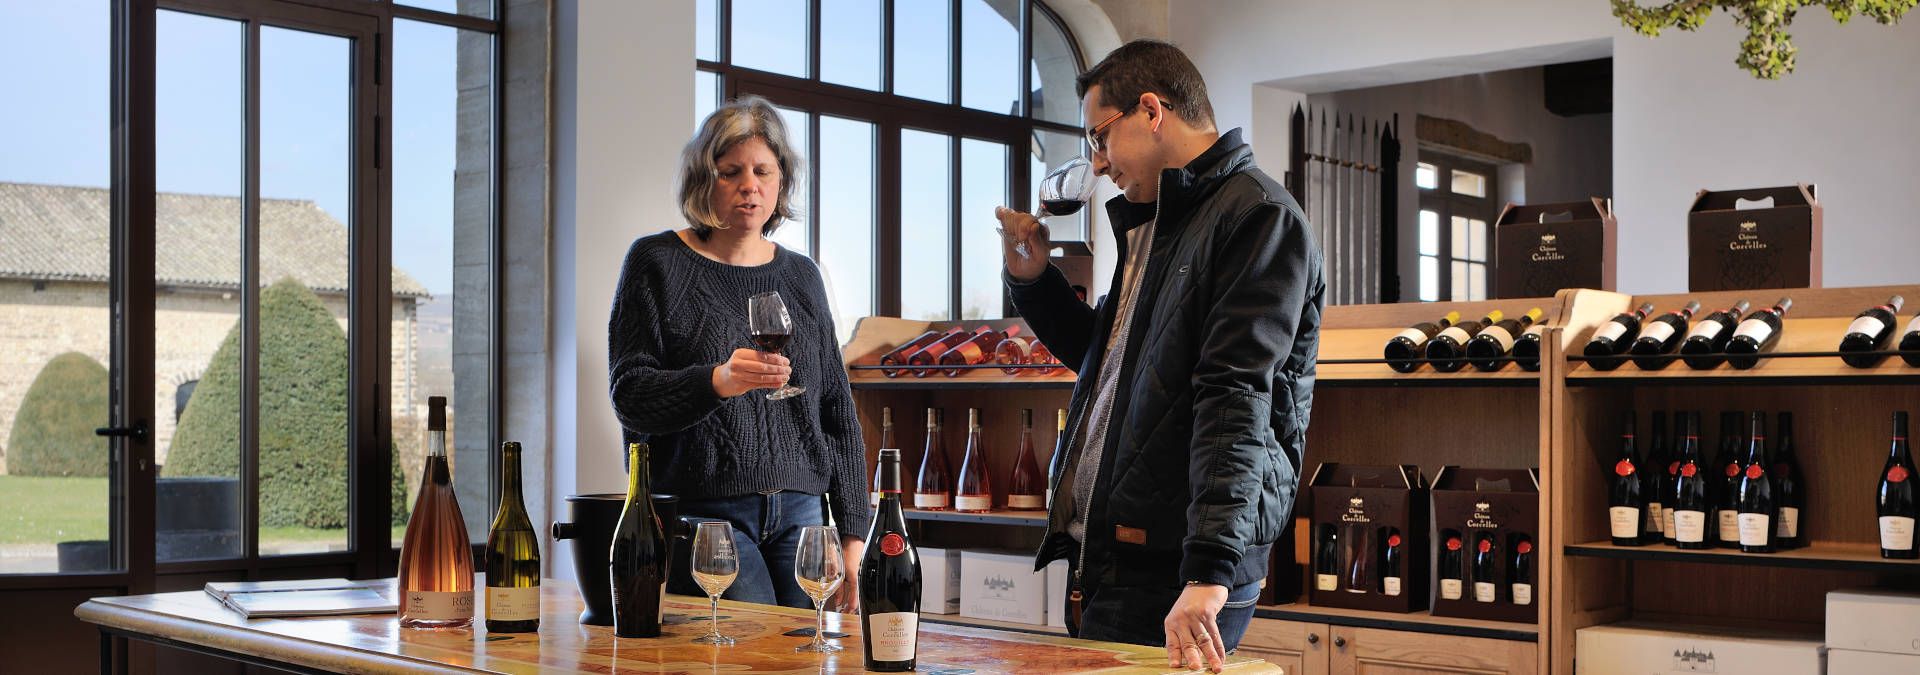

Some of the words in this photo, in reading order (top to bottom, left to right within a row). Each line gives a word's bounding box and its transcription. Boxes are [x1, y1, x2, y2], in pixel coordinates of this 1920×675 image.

[1729, 240, 1767, 250] Corcelles
[1531, 252, 1564, 261] Corcelles
[1342, 513, 1370, 523] Corcelles
[1466, 519, 1498, 529] Corcelles
